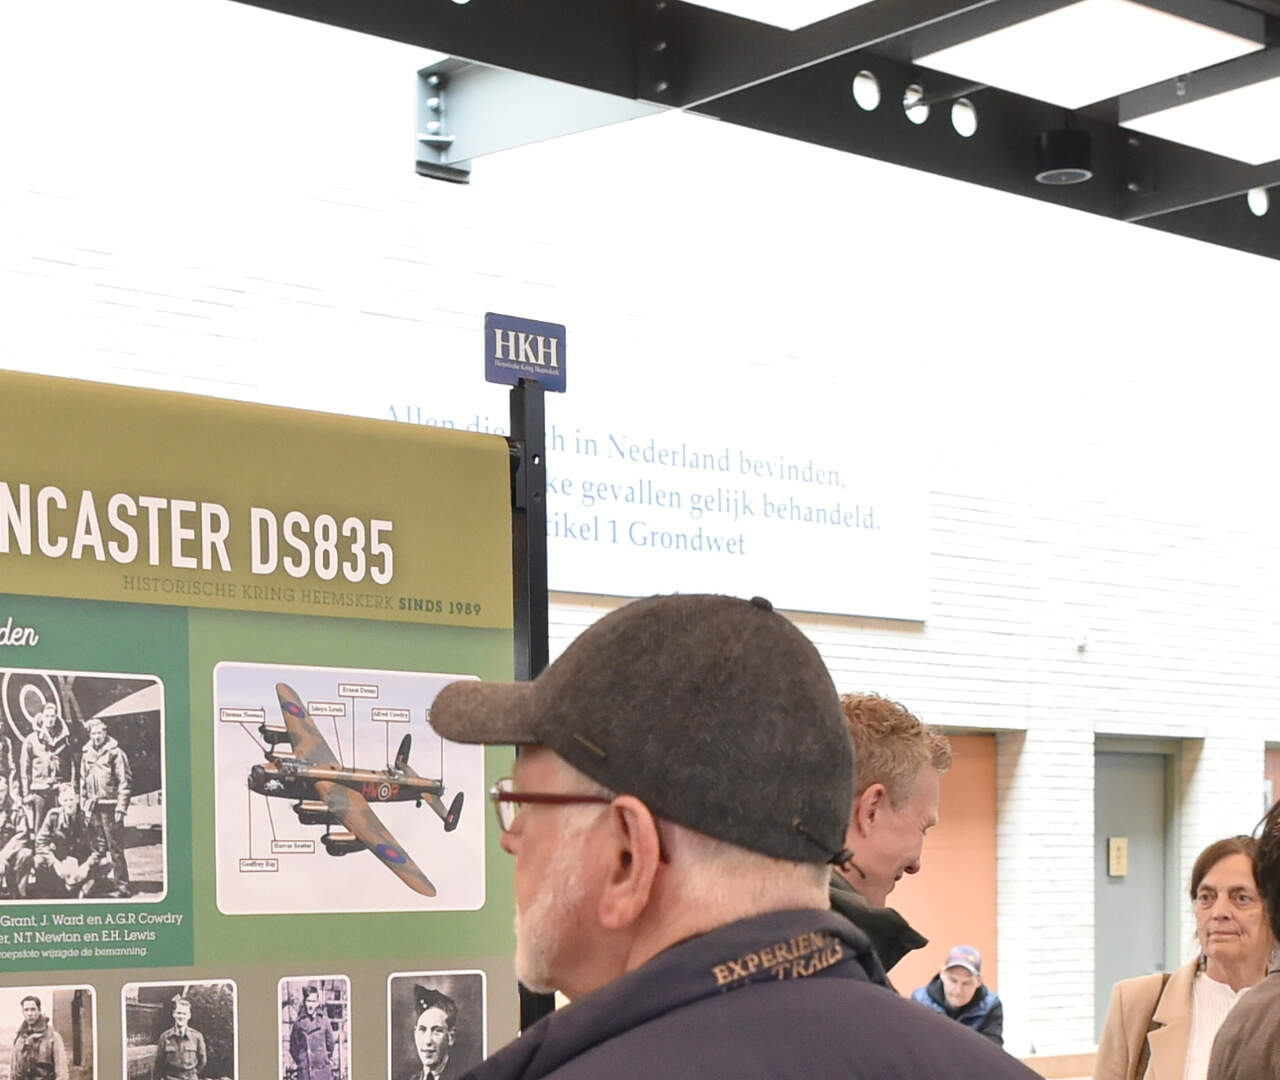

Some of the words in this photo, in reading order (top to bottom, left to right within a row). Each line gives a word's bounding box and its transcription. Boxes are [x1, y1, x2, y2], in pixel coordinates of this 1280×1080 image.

[494, 328, 558, 368] HKH
[575, 428, 597, 456] in
[607, 433, 730, 472] Nederland
[739, 449, 845, 489] bevinden,
[581, 478, 682, 509] gevallen
[689, 487, 754, 522] gelijk
[763, 493, 880, 530] behandeld.
[251, 505, 394, 585] DS835
[629, 523, 743, 554] Grondwet
[123, 575, 235, 597] HISTORISCHE
[242, 584, 294, 602] KRING
[301, 589, 393, 609] HEEMSKERK
[398, 597, 442, 613] SINDS
[449, 601, 481, 616] 1989
[35, 931, 81, 943] Newton
[83, 932, 99, 941] en
[101, 929, 121, 941] E.H.
[124, 929, 156, 940] Lewis
[39, 914, 49, 926] J.
[51, 914, 84, 925] Ward
[86, 915, 102, 925] en
[138, 912, 183, 925] Cowdry
